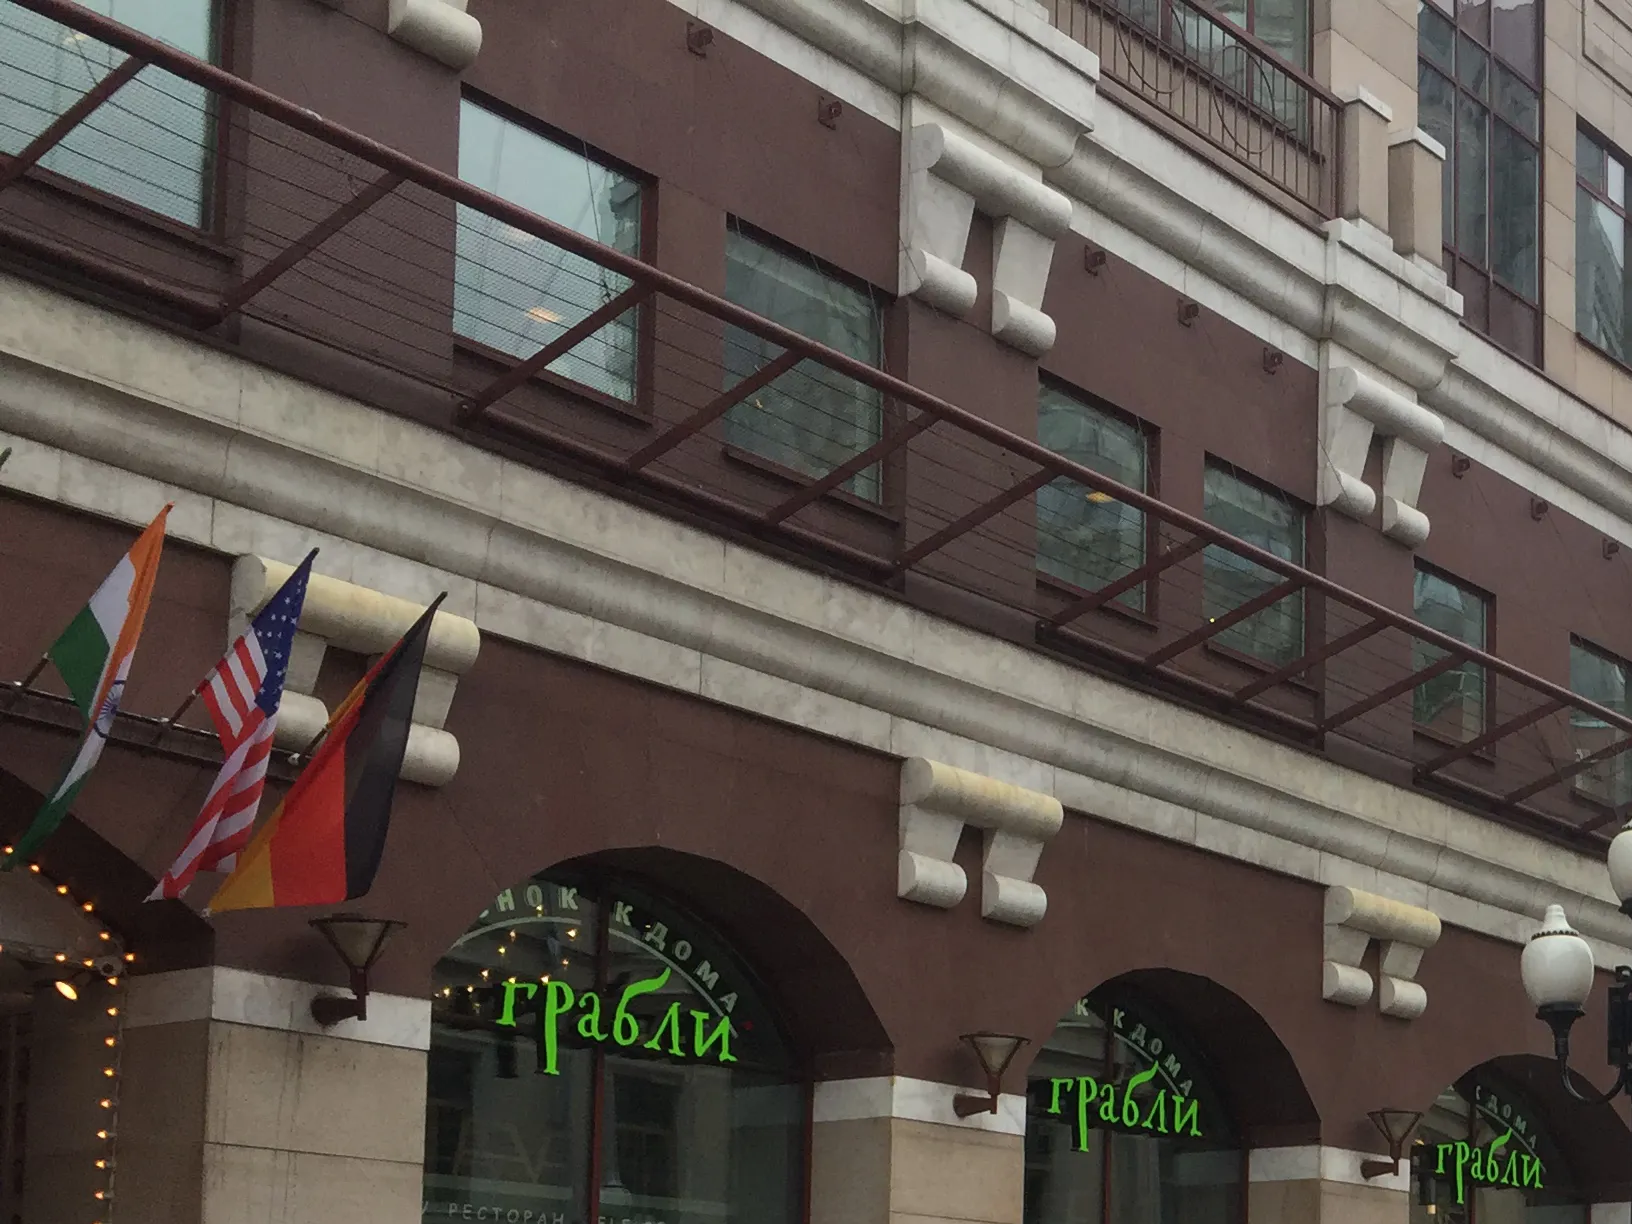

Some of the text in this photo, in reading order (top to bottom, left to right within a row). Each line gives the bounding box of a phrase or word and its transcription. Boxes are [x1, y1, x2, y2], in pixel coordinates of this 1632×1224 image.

[479, 884, 578, 918] НОК
[644, 921, 738, 1013] ДОМА
[1131, 1023, 1193, 1096] ДОМА
